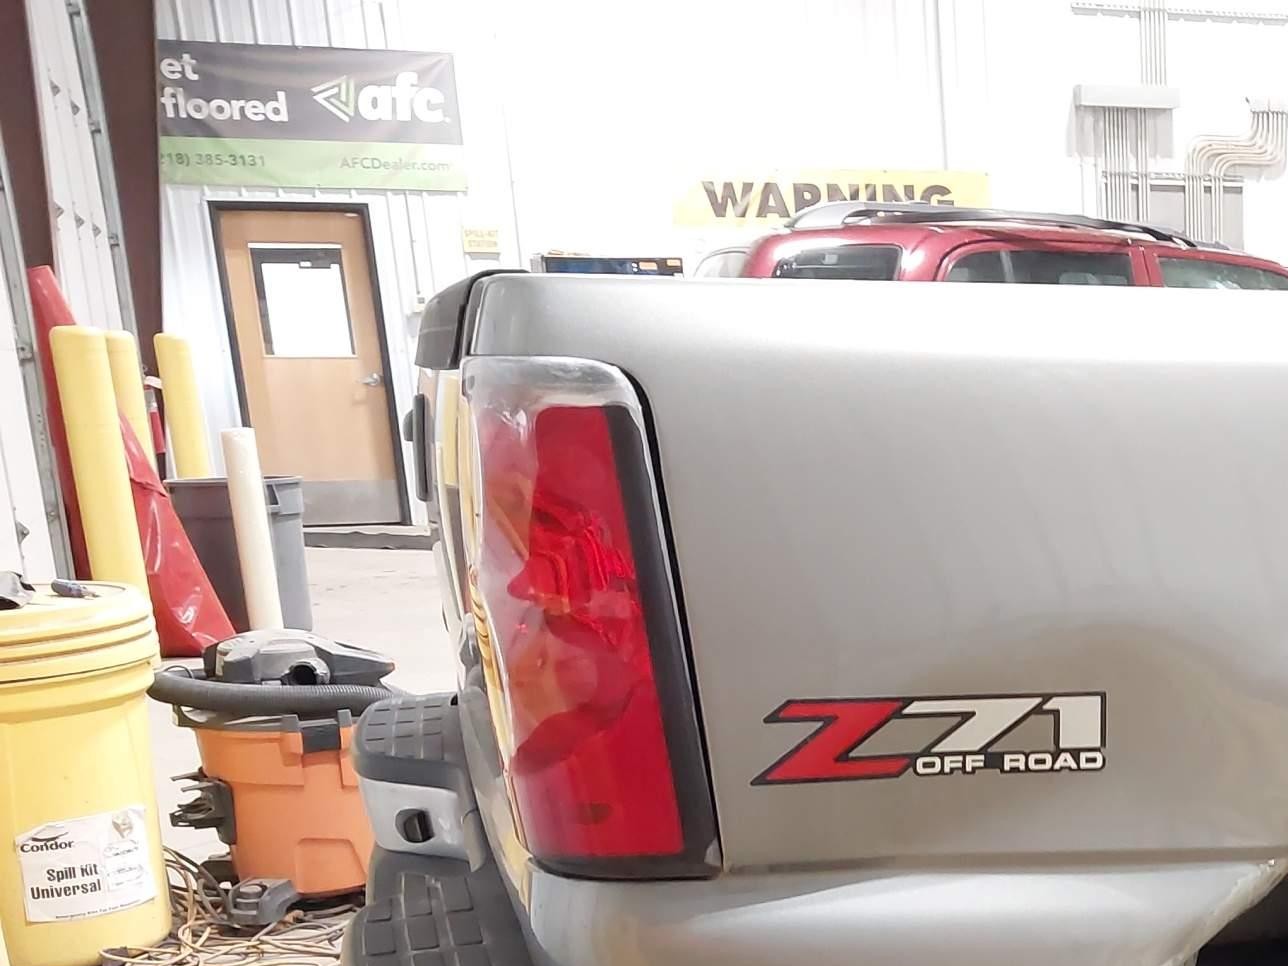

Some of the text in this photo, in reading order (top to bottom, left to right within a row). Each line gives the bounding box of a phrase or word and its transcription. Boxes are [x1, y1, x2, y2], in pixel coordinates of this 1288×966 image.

[160, 87, 288, 121] floored
[195, 154, 265, 167] 385-3131
[340, 157, 450, 172] AFCDealer.com
[751, 692, 1106, 785] Z71
[916, 752, 1104, 775] OFF ROAD
[20, 840, 75, 854] Condor
[46, 866, 77, 883] Spill
[80, 863, 99, 878] Kit
[30, 879, 102, 900] Universal
